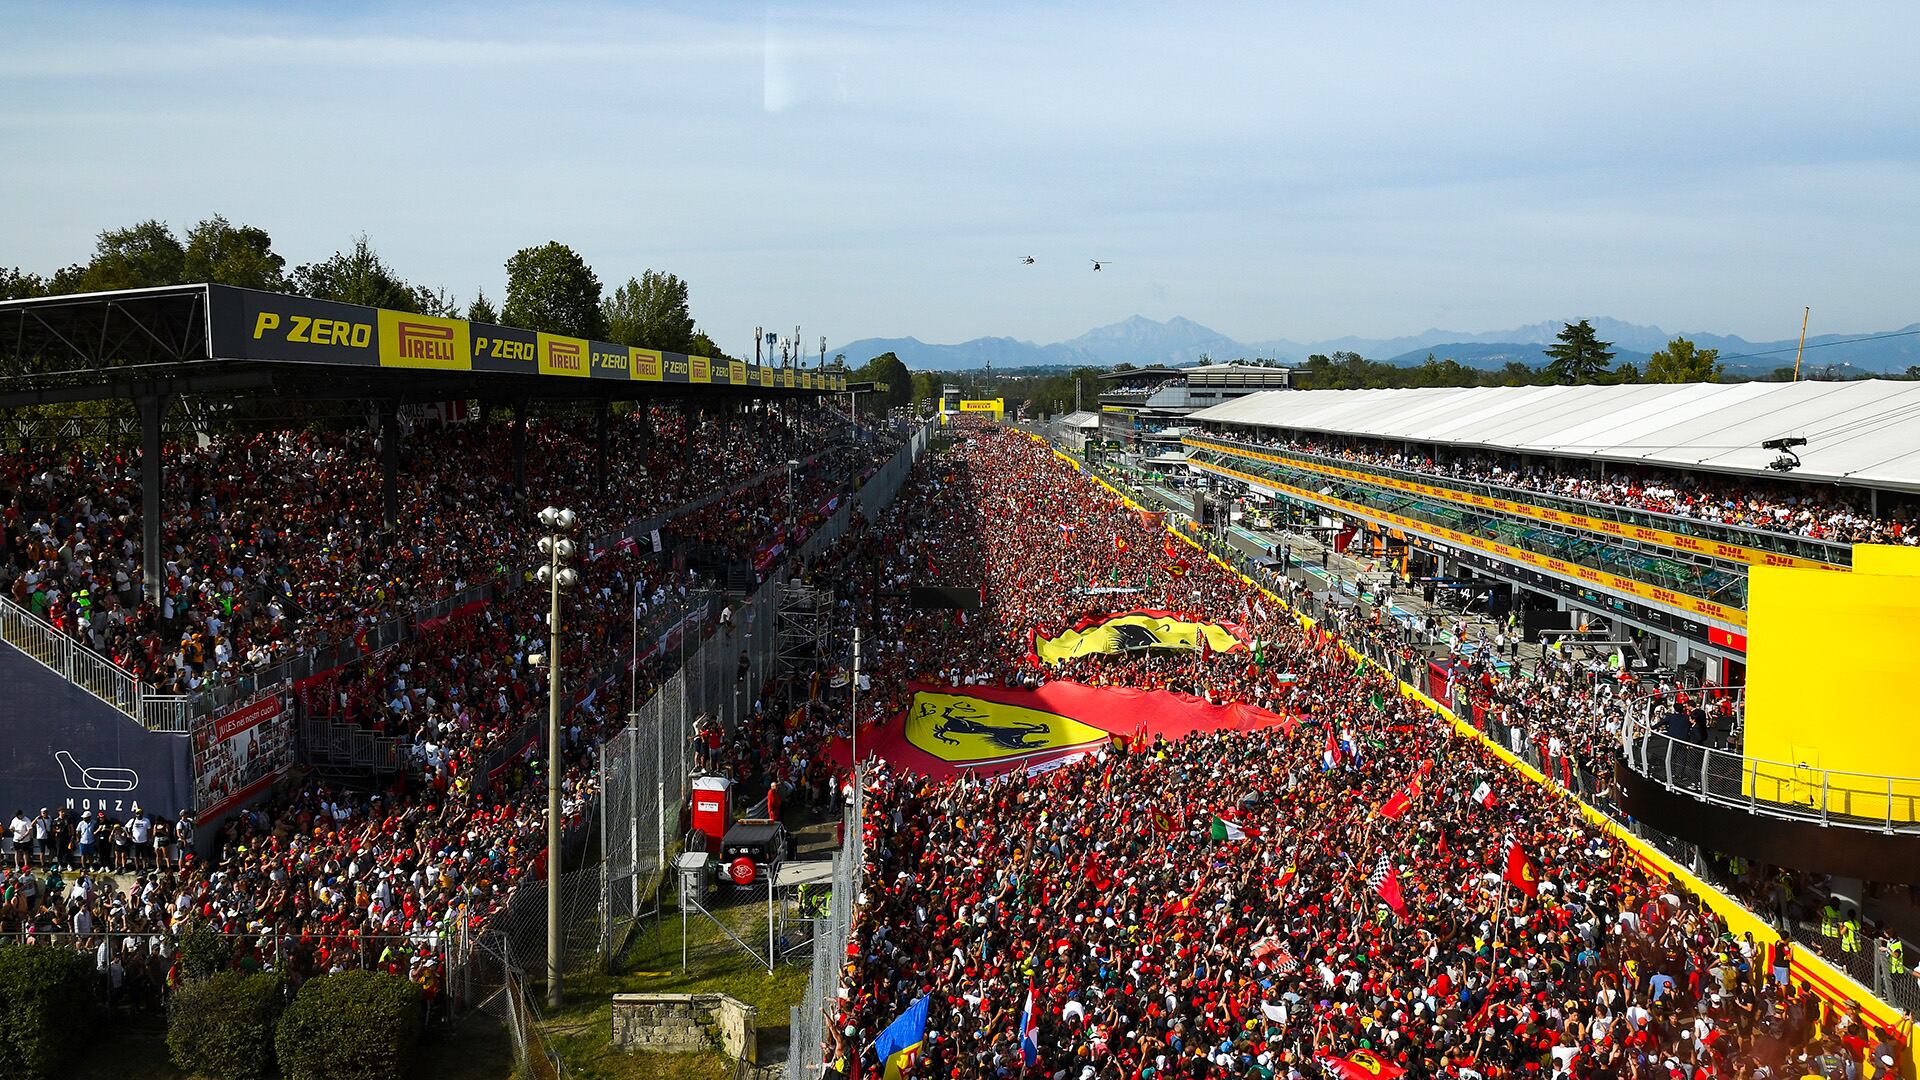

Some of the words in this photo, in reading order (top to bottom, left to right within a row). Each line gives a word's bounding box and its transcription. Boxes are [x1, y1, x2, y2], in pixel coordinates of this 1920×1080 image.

[253, 311, 280, 339] P
[286, 315, 372, 348] ZERO
[398, 321, 455, 361] PIRELLI
[475, 337, 488, 356] P
[490, 339, 535, 361] ZERO
[548, 341, 580, 370] PIRELLI
[592, 352, 600, 367] P
[601, 353, 628, 370] ZERO
[636, 353, 657, 376] PIRELLI
[663, 360, 669, 373] P
[670, 361, 688, 374] ZERO
[1493, 501, 1508, 509] DHL
[1517, 505, 1532, 514] DHL
[1542, 510, 1559, 521] DHL
[1570, 515, 1589, 527] DHL
[1601, 522, 1621, 534] DHL
[1635, 529, 1658, 542] DHL
[1494, 545, 1508, 555] DHL
[1674, 536, 1700, 550] DHL
[1520, 551, 1536, 563] DHL
[1716, 545, 1745, 560] DHL
[1548, 559, 1566, 572] DHL
[1764, 554, 1795, 567] DHL
[1579, 568, 1599, 581] DHL
[1613, 577, 1636, 593] DHL
[1652, 589, 1677, 605] DHL
[1695, 601, 1725, 618] DHL
[219, 719, 237, 738] JULES
[237, 715, 246, 728] nei
[260, 701, 275, 717] cuori
[66, 797, 139, 812] MONZA
